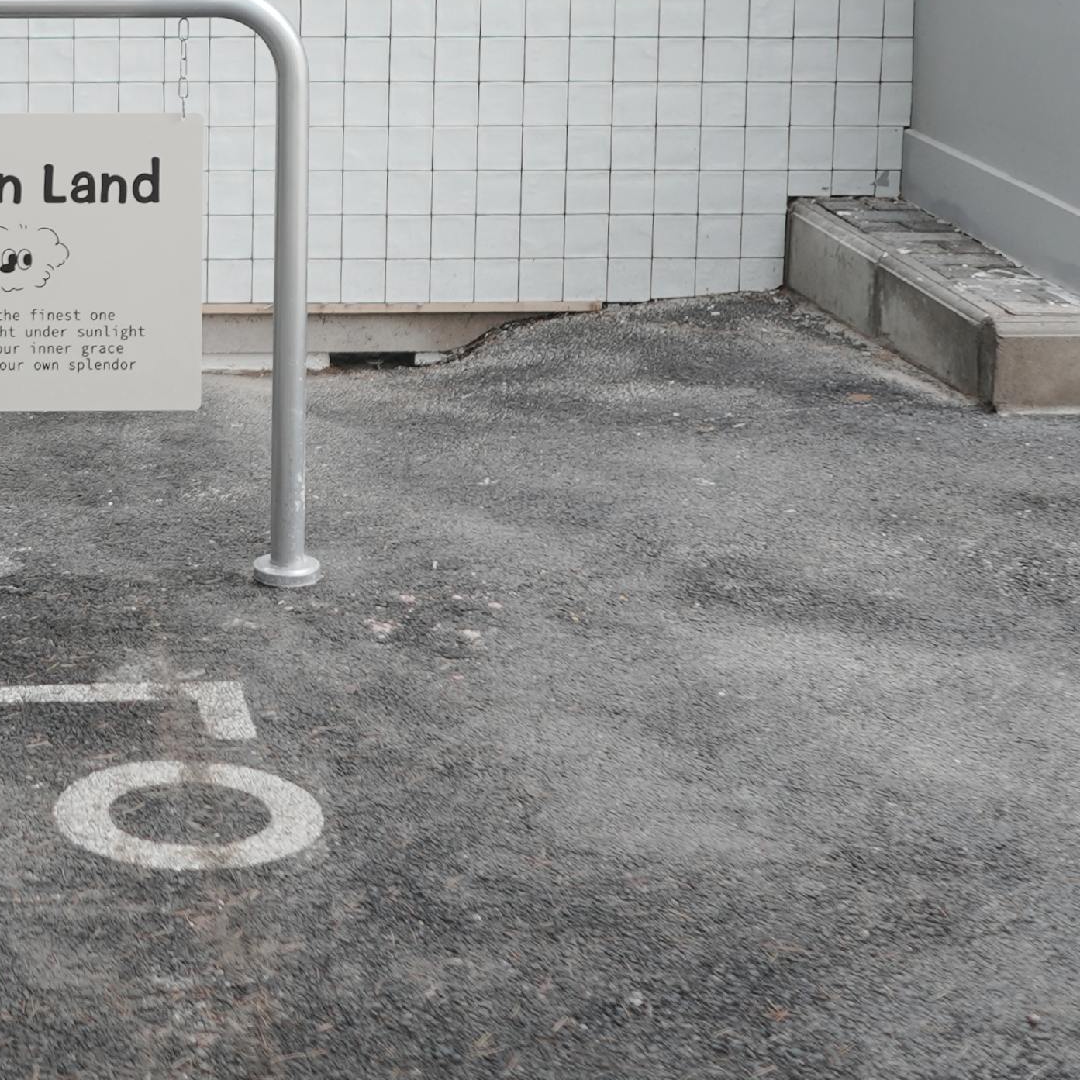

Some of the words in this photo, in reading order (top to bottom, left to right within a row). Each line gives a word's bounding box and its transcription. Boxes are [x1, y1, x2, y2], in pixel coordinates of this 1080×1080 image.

[42, 156, 161, 205] Land
[30, 308, 81, 322] finest
[90, 311, 116, 321] one
[25, 325, 67, 338] under
[77, 324, 145, 341] sunlight
[30, 342, 72, 355] inner
[81, 344, 124, 358] grace
[33, 361, 59, 372] own
[69, 357, 137, 374] splendor
